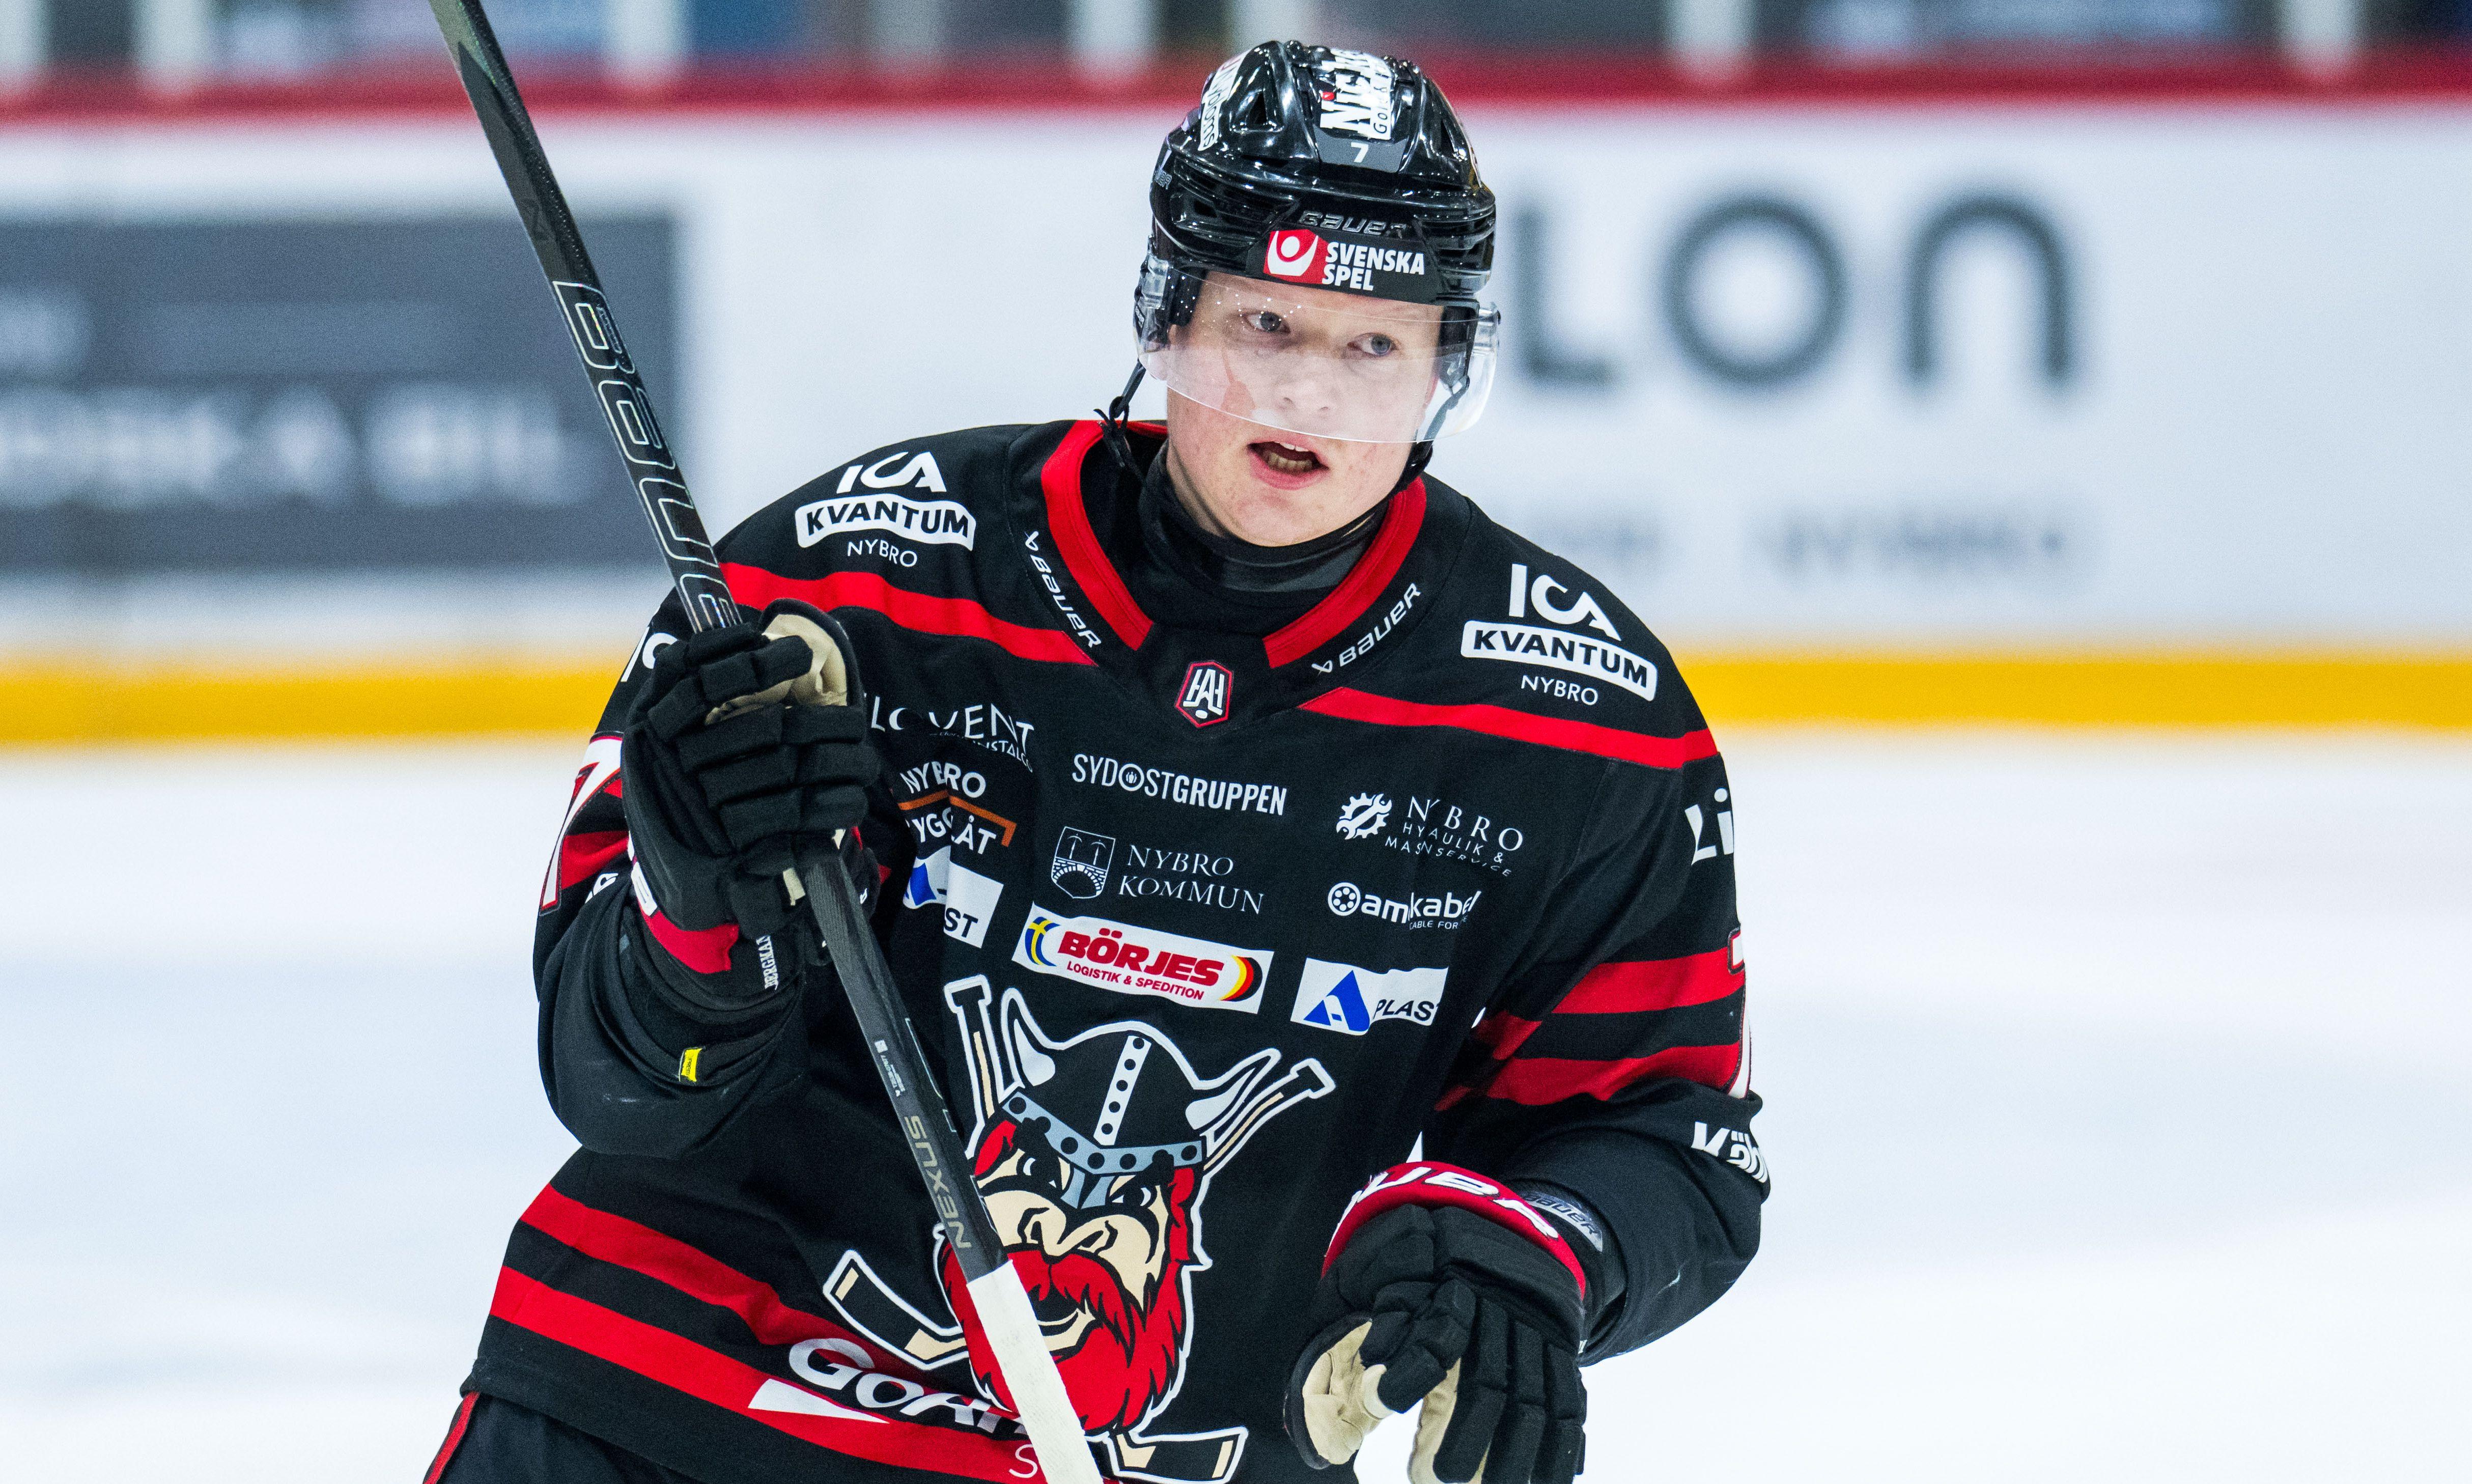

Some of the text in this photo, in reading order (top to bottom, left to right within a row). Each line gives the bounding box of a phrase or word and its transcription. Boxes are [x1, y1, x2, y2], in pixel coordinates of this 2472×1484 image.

[1351, 142, 1369, 163] 7
[1322, 264, 1374, 291] SPEL
[1325, 241, 1424, 275] SVENSKA
[836, 451, 947, 494] ICA
[806, 500, 969, 538] KVANTUM
[847, 539, 918, 567] NYBRO
[1030, 553, 1102, 649] BAUER
[1508, 563, 1622, 640] ICA
[1338, 582, 1421, 667] BAUER
[1473, 629, 1648, 688] KVANTUM
[1520, 674, 1598, 706] NYBRO
[900, 761, 987, 798] NYBRO
[1072, 753, 1287, 816] SYDOSTGRUPPEN
[1127, 844, 1234, 877] NYBRO
[1402, 822, 1503, 864] HYAULIK &
[1118, 875, 1265, 915] KOMMUN
[1361, 890, 1482, 924] amkabel
[1057, 928, 1225, 987] BÖRJES
[1066, 961, 1204, 1000] LOGISTIK & SPEDITION
[1372, 999, 1440, 1021] PLAS
[904, 1114, 972, 1249] NEXUS
